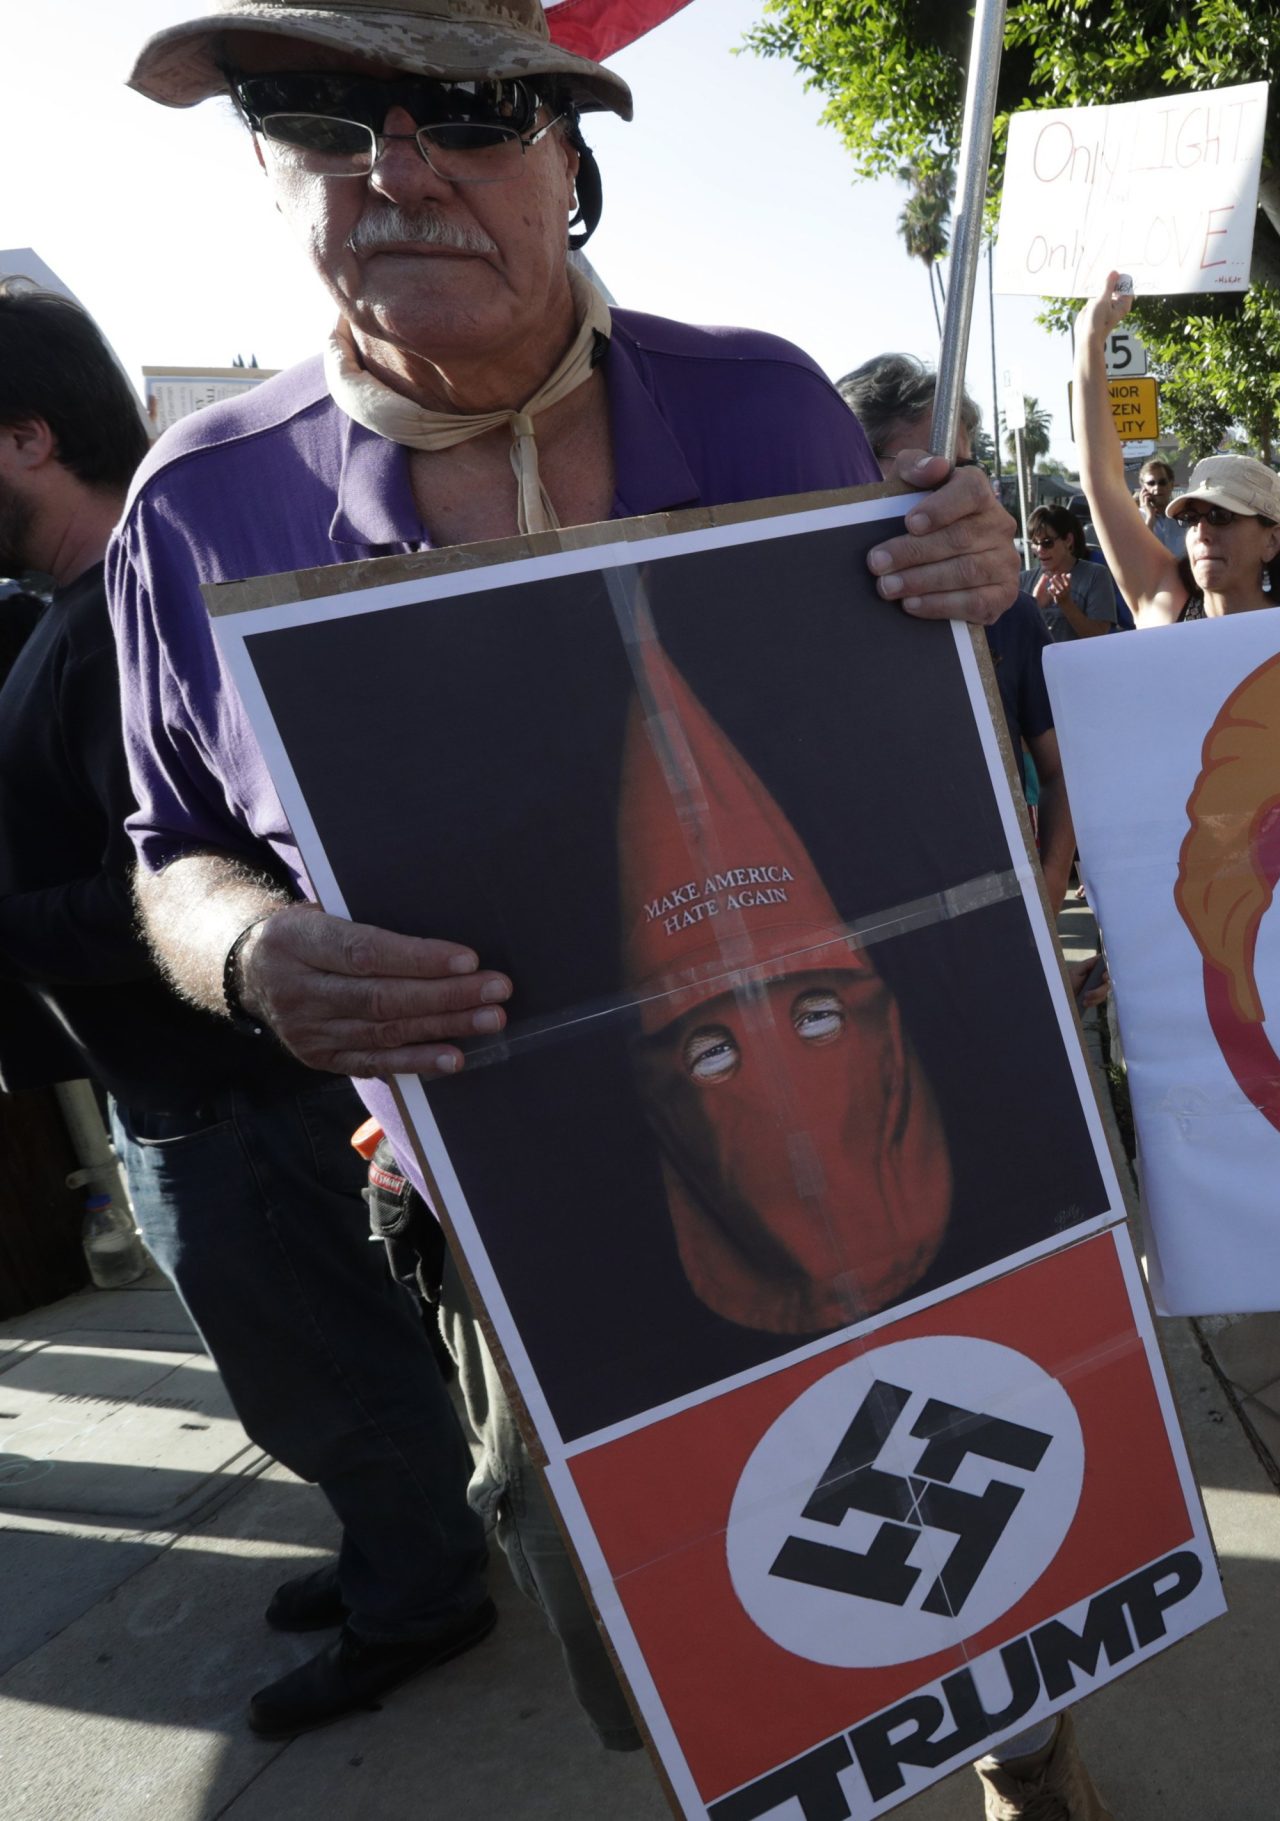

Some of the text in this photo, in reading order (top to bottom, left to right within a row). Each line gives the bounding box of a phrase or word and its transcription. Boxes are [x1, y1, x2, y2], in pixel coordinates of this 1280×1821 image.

[1104, 335, 1132, 369] 5
[1108, 386, 1139, 398] NIOR
[1112, 404, 1141, 416] ZEN
[1115, 421, 1146, 433] LITY
[643, 866, 795, 923] MAKE AMERICA
[663, 887, 788, 936] HATE AGAIN
[706, 1550, 1203, 1821] TRUMP
